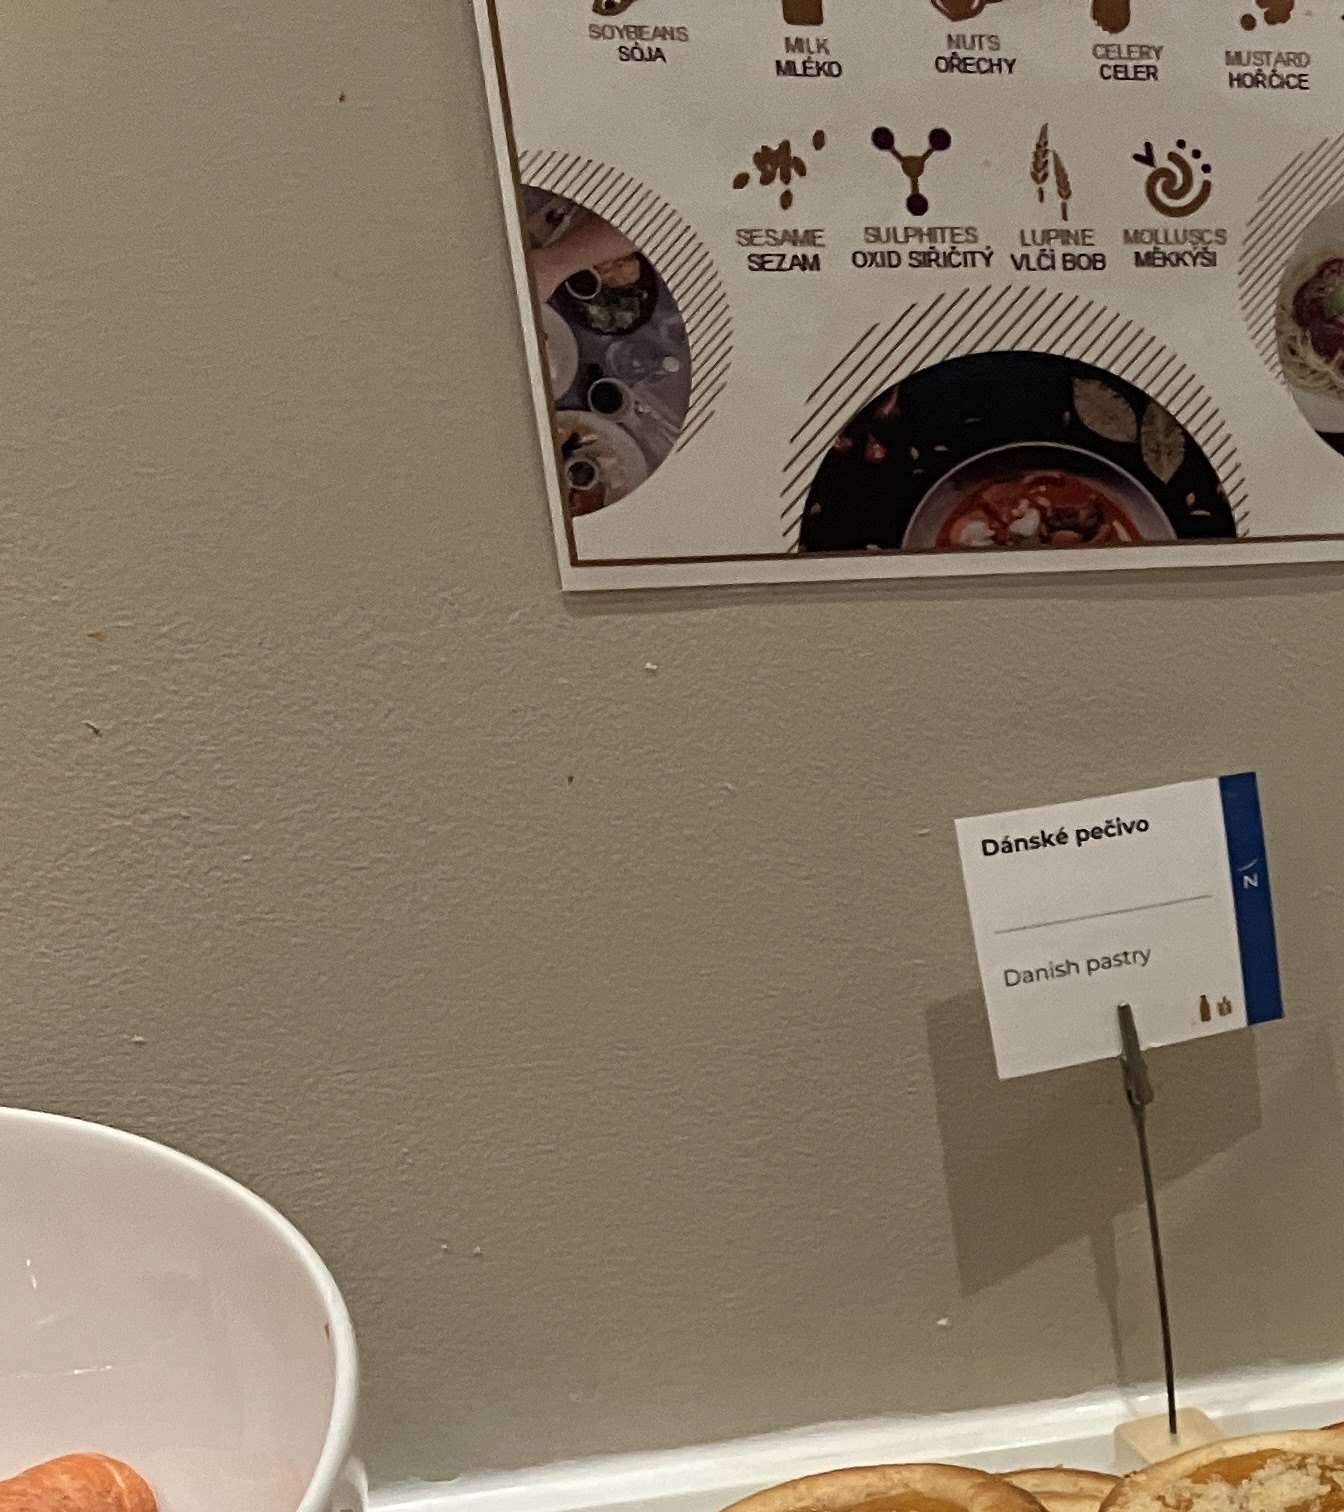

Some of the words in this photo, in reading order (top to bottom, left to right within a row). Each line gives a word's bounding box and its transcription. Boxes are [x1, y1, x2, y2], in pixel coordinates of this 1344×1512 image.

[588, 23, 690, 43] SOYBEANS
[946, 33, 1000, 51] NUTS
[618, 41, 667, 63] SÓJA
[784, 36, 831, 55] MILK
[1092, 43, 1164, 61] CELERY
[775, 55, 843, 78] MLÉKO
[935, 51, 1017, 75] OŘECHY
[1225, 50, 1311, 68] MUSTARD
[1100, 64, 1159, 82] CELER
[1228, 68, 1310, 91] HOŘČICE
[735, 227, 826, 248] SESAME
[863, 226, 980, 244] SULPHITES
[1020, 228, 1096, 247] LUPINE
[1123, 228, 1228, 246] MOLLUSCS
[747, 253, 822, 272] SEZAM
[851, 250, 902, 269] OXID
[1010, 247, 1056, 271] VLČÍ
[1061, 252, 1107, 271] BOB
[981, 827, 1069, 857] Dánské
[1075, 816, 1150, 848] pečivo
[1003, 958, 1081, 988] Danish
[1086, 948, 1152, 976] pastry
